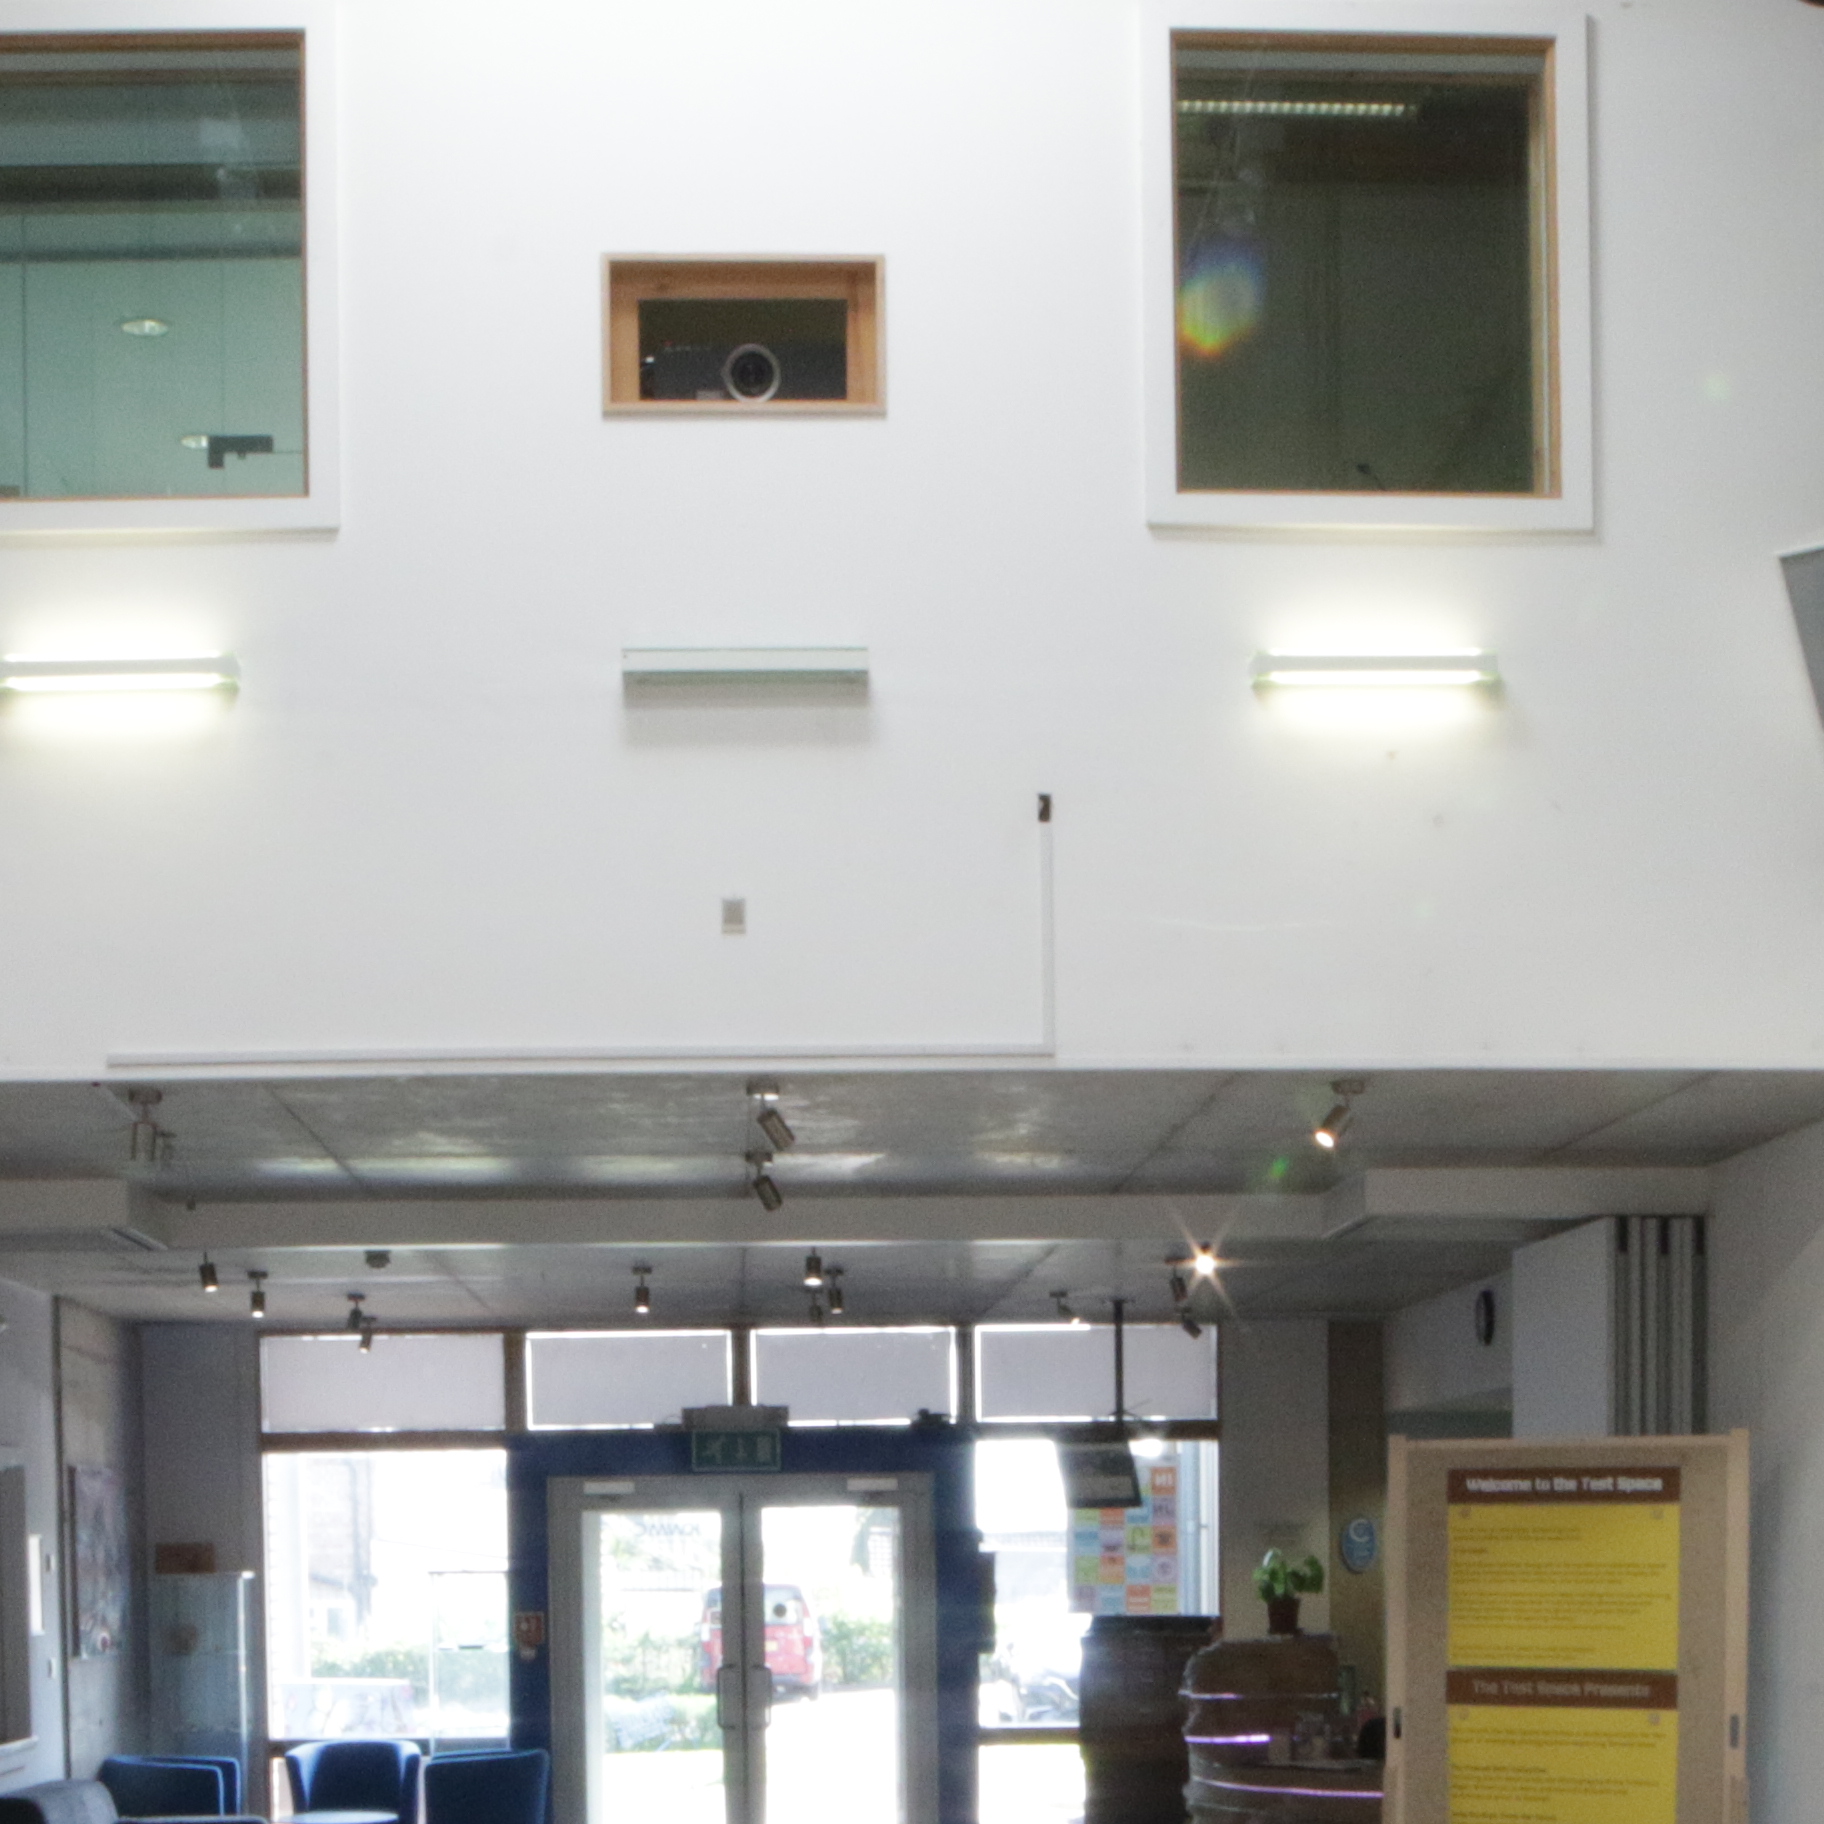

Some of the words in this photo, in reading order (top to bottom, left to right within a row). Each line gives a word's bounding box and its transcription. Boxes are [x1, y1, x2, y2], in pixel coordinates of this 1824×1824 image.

[1466, 1477, 1533, 1493] Welcome
[1534, 1477, 1552, 1493] to
[1553, 1476, 1578, 1493] the
[1581, 1477, 1614, 1493] Test
[1616, 1476, 1664, 1494] Space
[1472, 1679, 1499, 1695] The
[1502, 1680, 1533, 1696] Test
